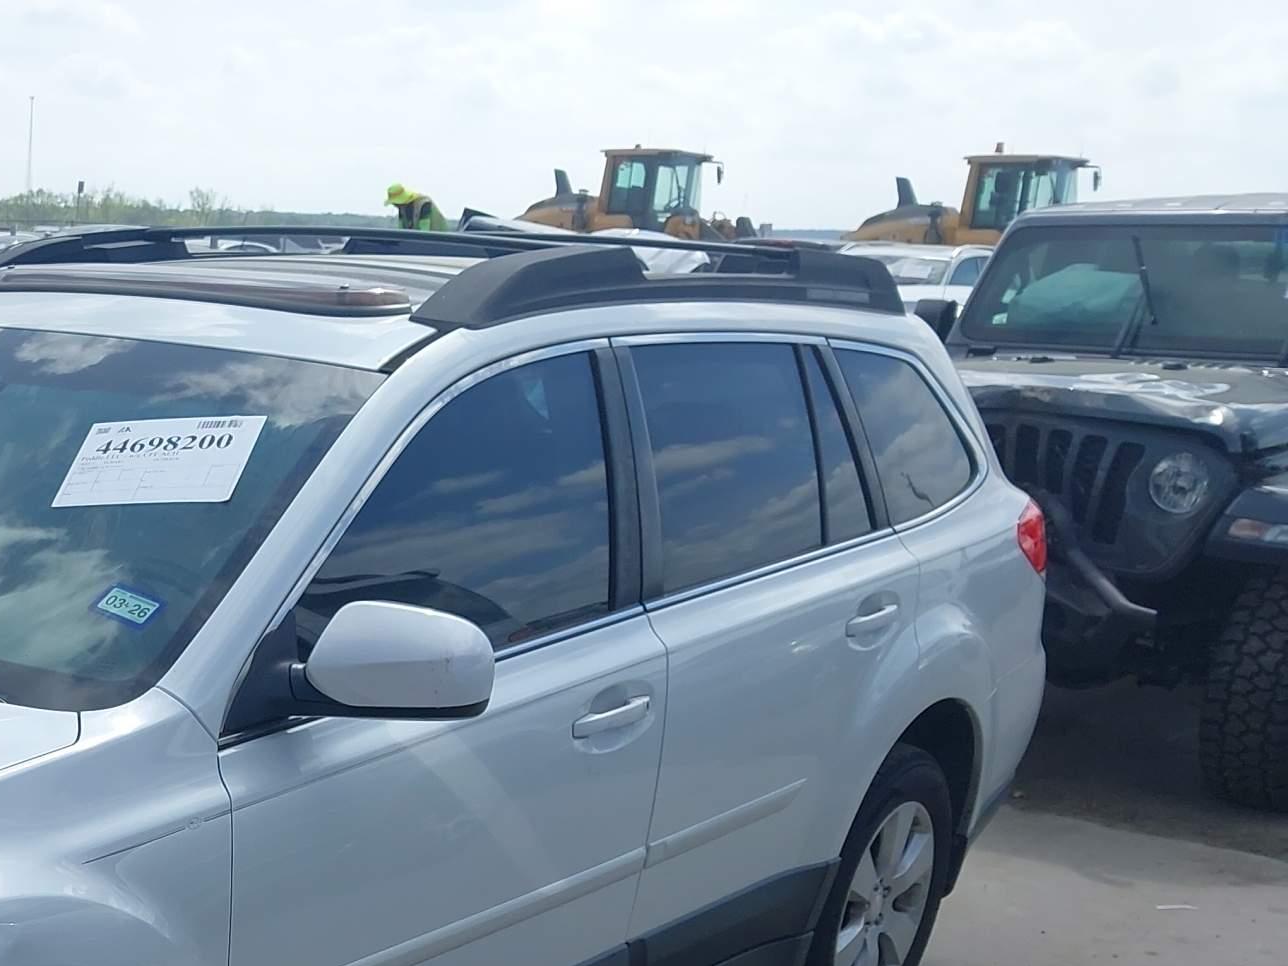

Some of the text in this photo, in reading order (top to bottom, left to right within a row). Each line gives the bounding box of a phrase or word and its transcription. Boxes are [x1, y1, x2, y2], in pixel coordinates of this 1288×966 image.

[96, 433, 234, 454] 44698200
[105, 595, 126, 609] 03
[128, 604, 150, 618] 26
